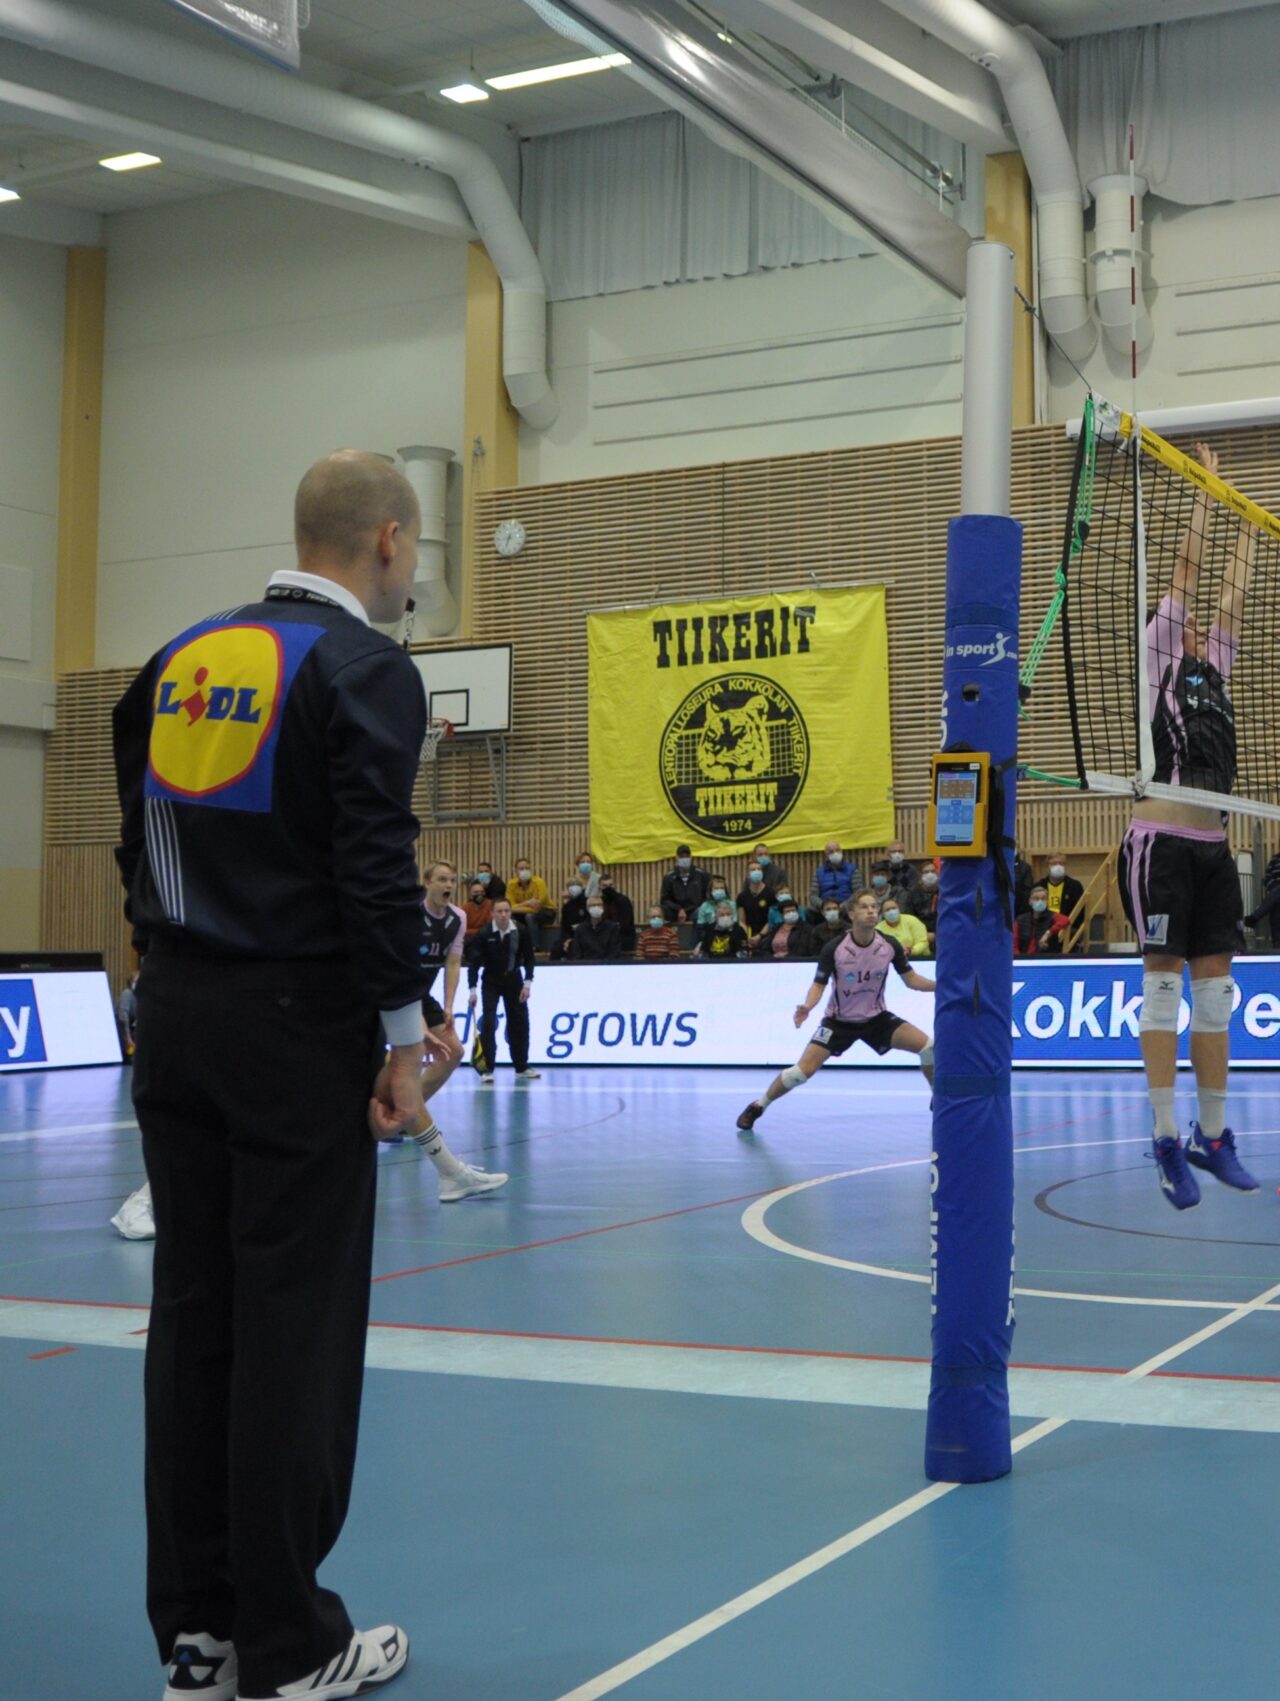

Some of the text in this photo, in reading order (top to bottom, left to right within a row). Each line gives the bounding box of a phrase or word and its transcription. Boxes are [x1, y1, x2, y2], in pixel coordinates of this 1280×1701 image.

[653, 605, 817, 669] TIIKERIT
[956, 643, 996, 657] sport
[664, 679, 806, 788] LENTOPALLOSEURA KOKKOLAN TIIKERIT
[695, 781, 779, 817] TIIKERIT
[723, 819, 753, 833] 1974
[857, 970, 871, 983] 14
[546, 1009, 698, 1059] grows
